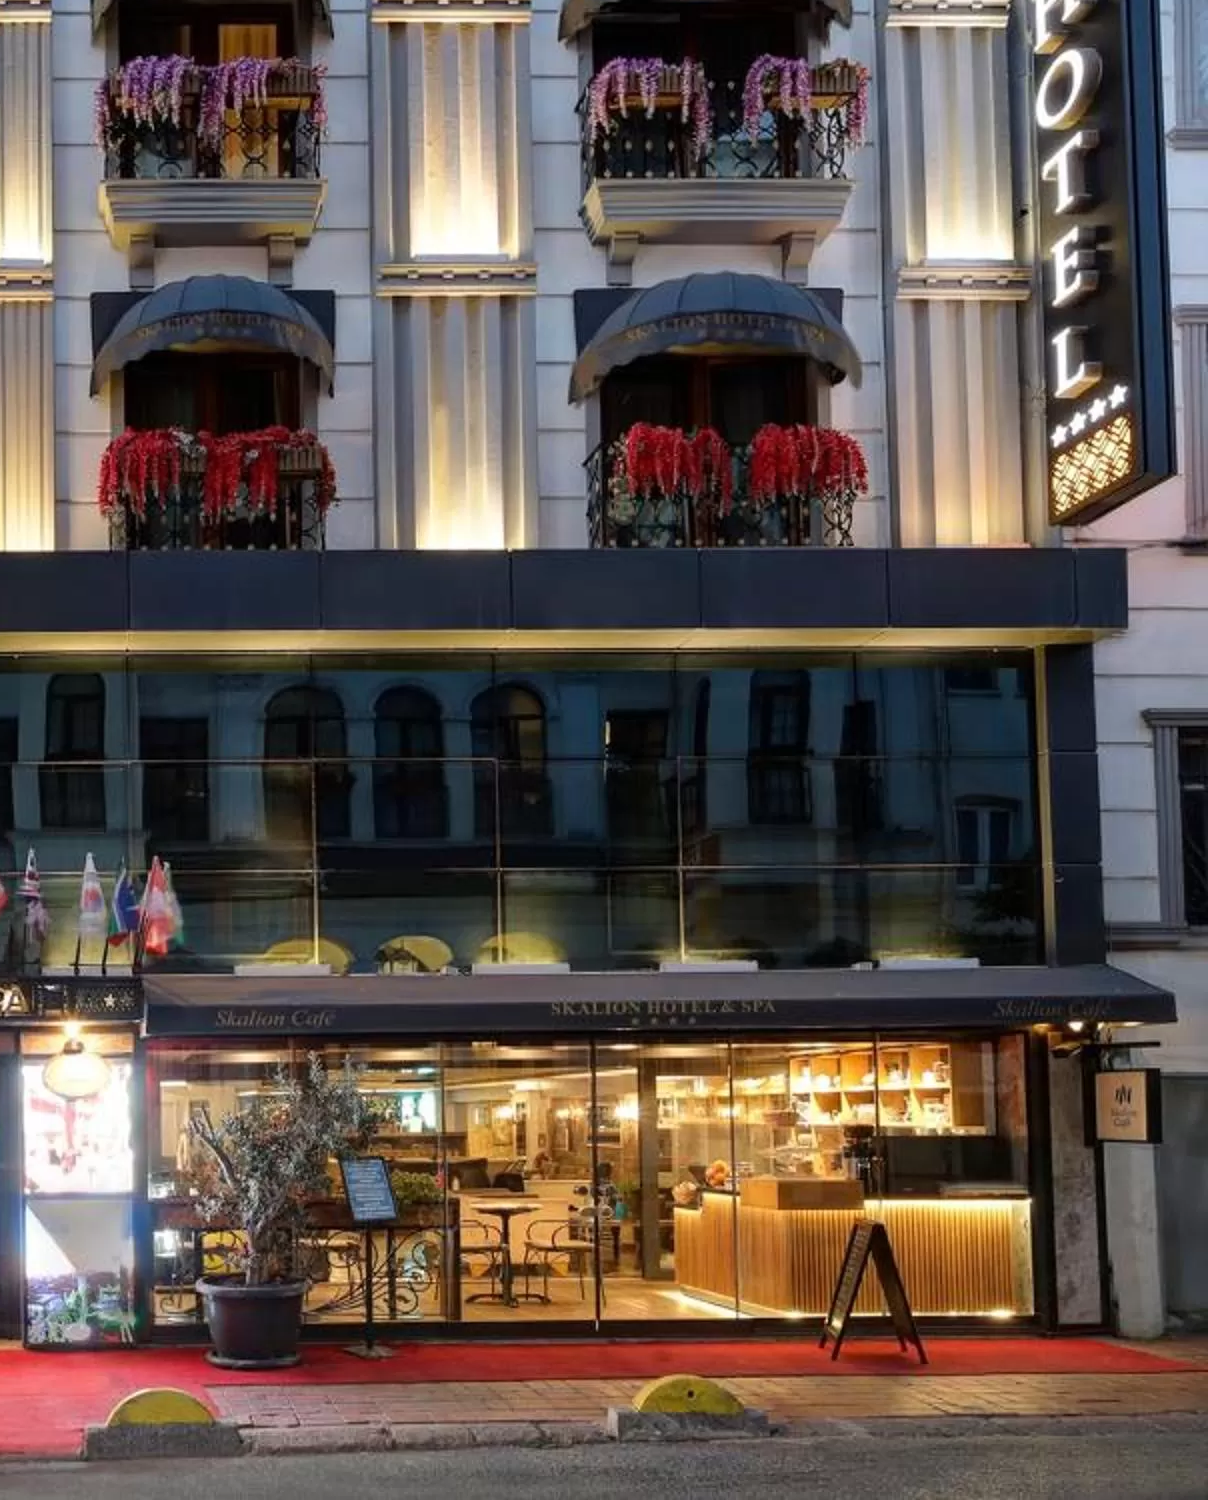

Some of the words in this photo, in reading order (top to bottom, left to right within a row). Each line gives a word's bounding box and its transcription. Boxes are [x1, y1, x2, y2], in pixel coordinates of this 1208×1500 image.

[551, 1000, 641, 1016] SKALION
[647, 999, 716, 1015] HOTEL
[720, 999, 736, 1013] &
[742, 999, 777, 1014] SPA
[215, 1008, 286, 1029] Skalion
